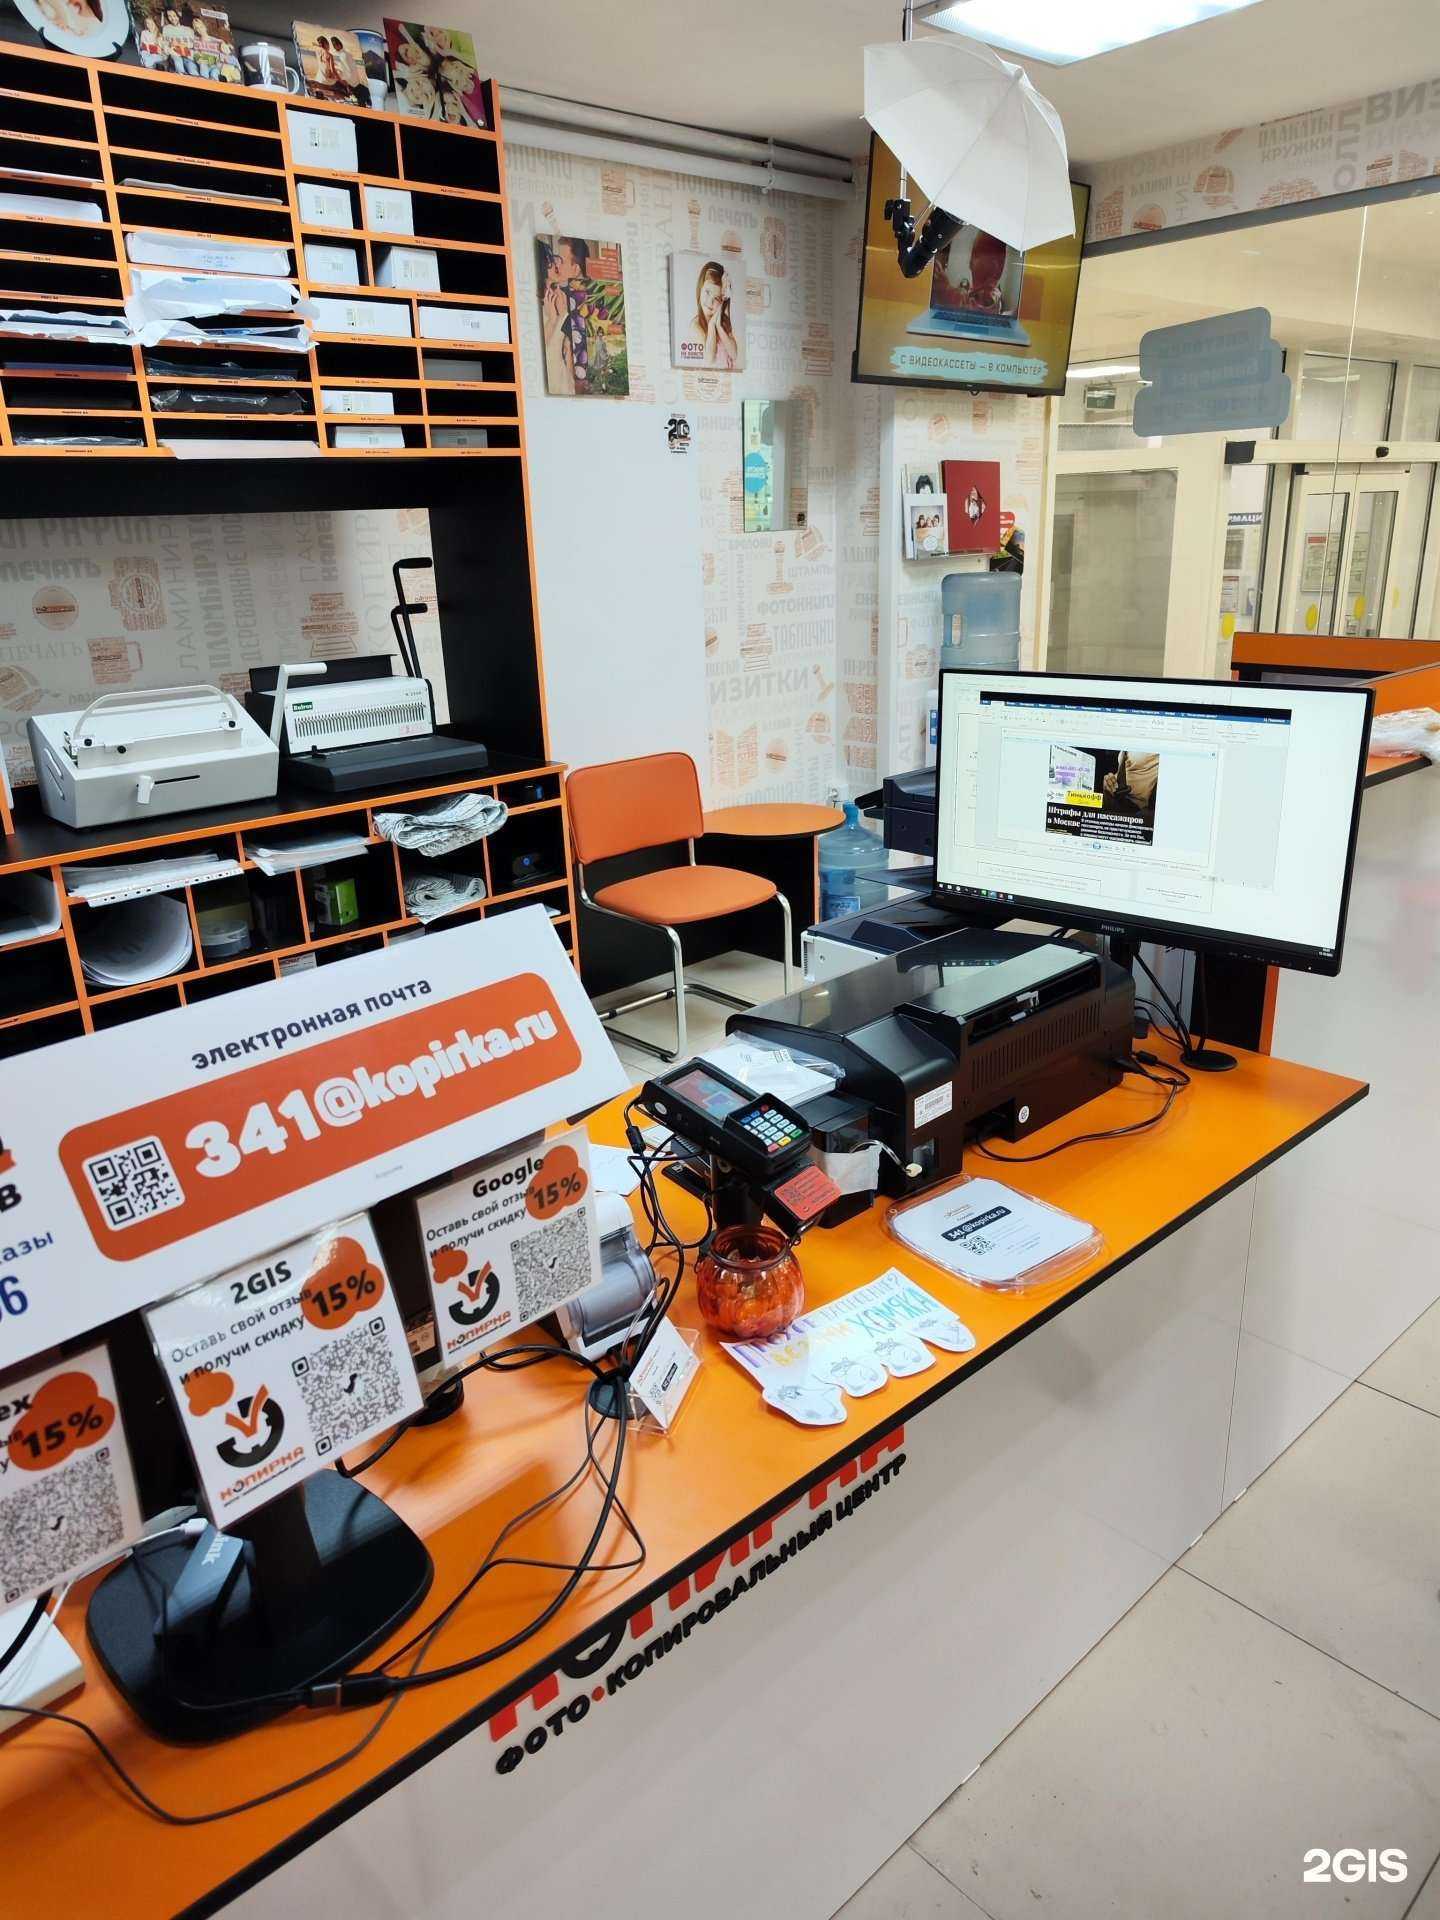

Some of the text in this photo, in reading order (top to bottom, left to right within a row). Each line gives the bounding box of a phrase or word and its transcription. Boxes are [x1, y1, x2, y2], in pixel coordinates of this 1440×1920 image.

[900, 354, 906, 365] С
[909, 355, 976, 370] ВИДЕОКАССЕТЫ
[988, 362, 993, 372] В
[995, 364, 1042, 376] КОМПЬЮТЕР
[1048, 805, 1081, 817] Штрафы
[1097, 813, 1144, 825] пассажиров
[1053, 817, 1081, 828] Москве
[1101, 924, 1125, 934] PHILIPS
[191, 977, 433, 1070] электронная почта
[185, 1009, 560, 1178] 341@kopirka.ru
[472, 1156, 544, 1198] Google
[532, 1172, 582, 1210] 15%
[426, 1218, 469, 1242] Оставь
[472, 1203, 500, 1222] свой
[438, 1227, 485, 1257] получи
[487, 1207, 527, 1233] скидку
[0, 1232, 54, 1264] азы
[230, 1261, 293, 1304] 2GIS
[311, 1269, 377, 1317] 15%
[846, 1286, 940, 1339] ХОМЯКА
[171, 1331, 227, 1364] Оставь
[230, 1309, 266, 1336] свой
[179, 1314, 306, 1386] и получи скидку
[22, 1404, 103, 1459] 15%
[496, 1453, 907, 1775] ФОТО КОПИРОВАЛЬНЫЙ ЦЕНТР
